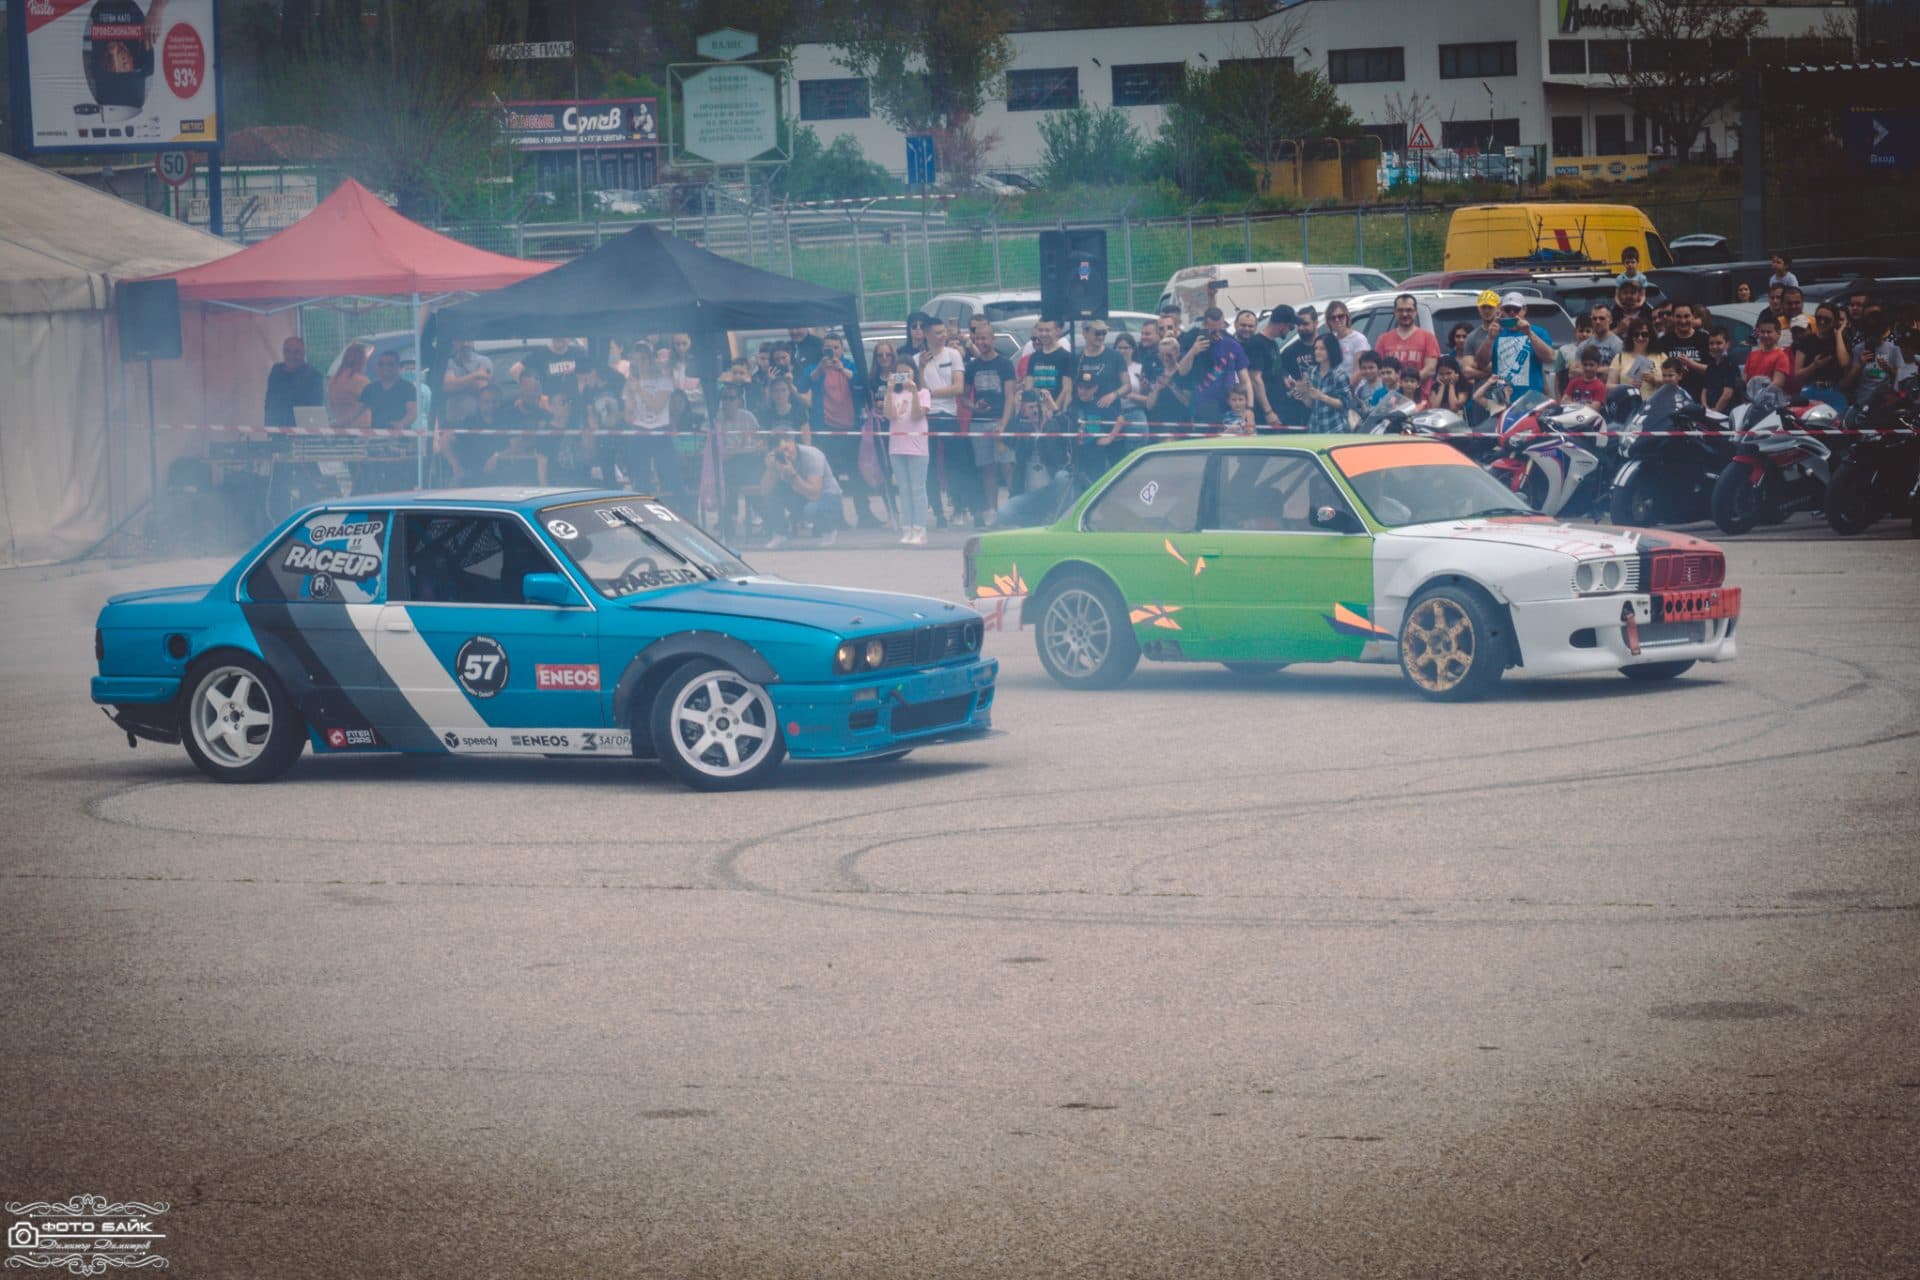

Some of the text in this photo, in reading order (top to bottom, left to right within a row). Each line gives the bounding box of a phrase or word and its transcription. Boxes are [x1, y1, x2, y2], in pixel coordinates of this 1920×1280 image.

[173, 68, 197, 87] 93%
[163, 154, 185, 175] 50
[311, 521, 382, 543] @RACEUP
[284, 546, 379, 577] RACEUP
[464, 654, 500, 681] 57
[539, 669, 599, 686] ENEOS
[345, 729, 370, 738] INTER
[463, 734, 498, 749] speedy
[523, 735, 569, 747] ENEOS
